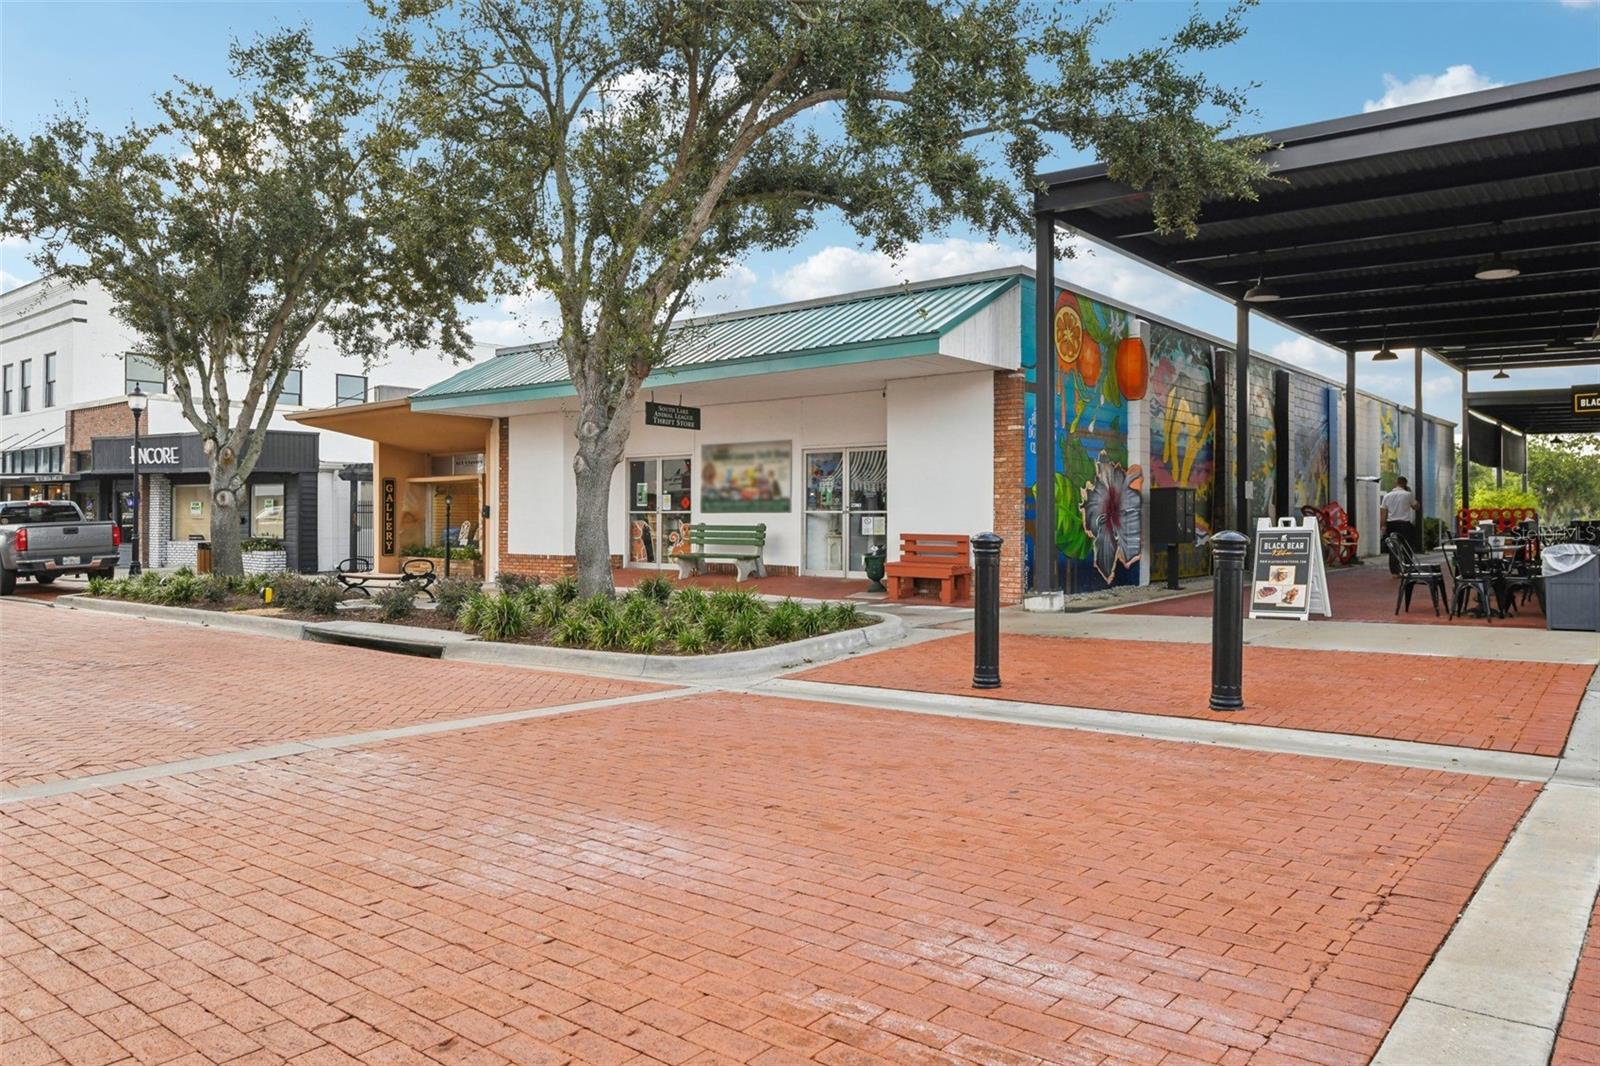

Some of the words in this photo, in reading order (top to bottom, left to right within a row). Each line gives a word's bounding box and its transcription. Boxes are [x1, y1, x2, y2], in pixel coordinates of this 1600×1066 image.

[652, 416, 675, 426] THRIFT
[676, 420, 696, 428] STORE
[385, 484, 393, 550] GALLERY
[1264, 542, 1285, 550] BLACK
[1286, 542, 1305, 550] BEAR
